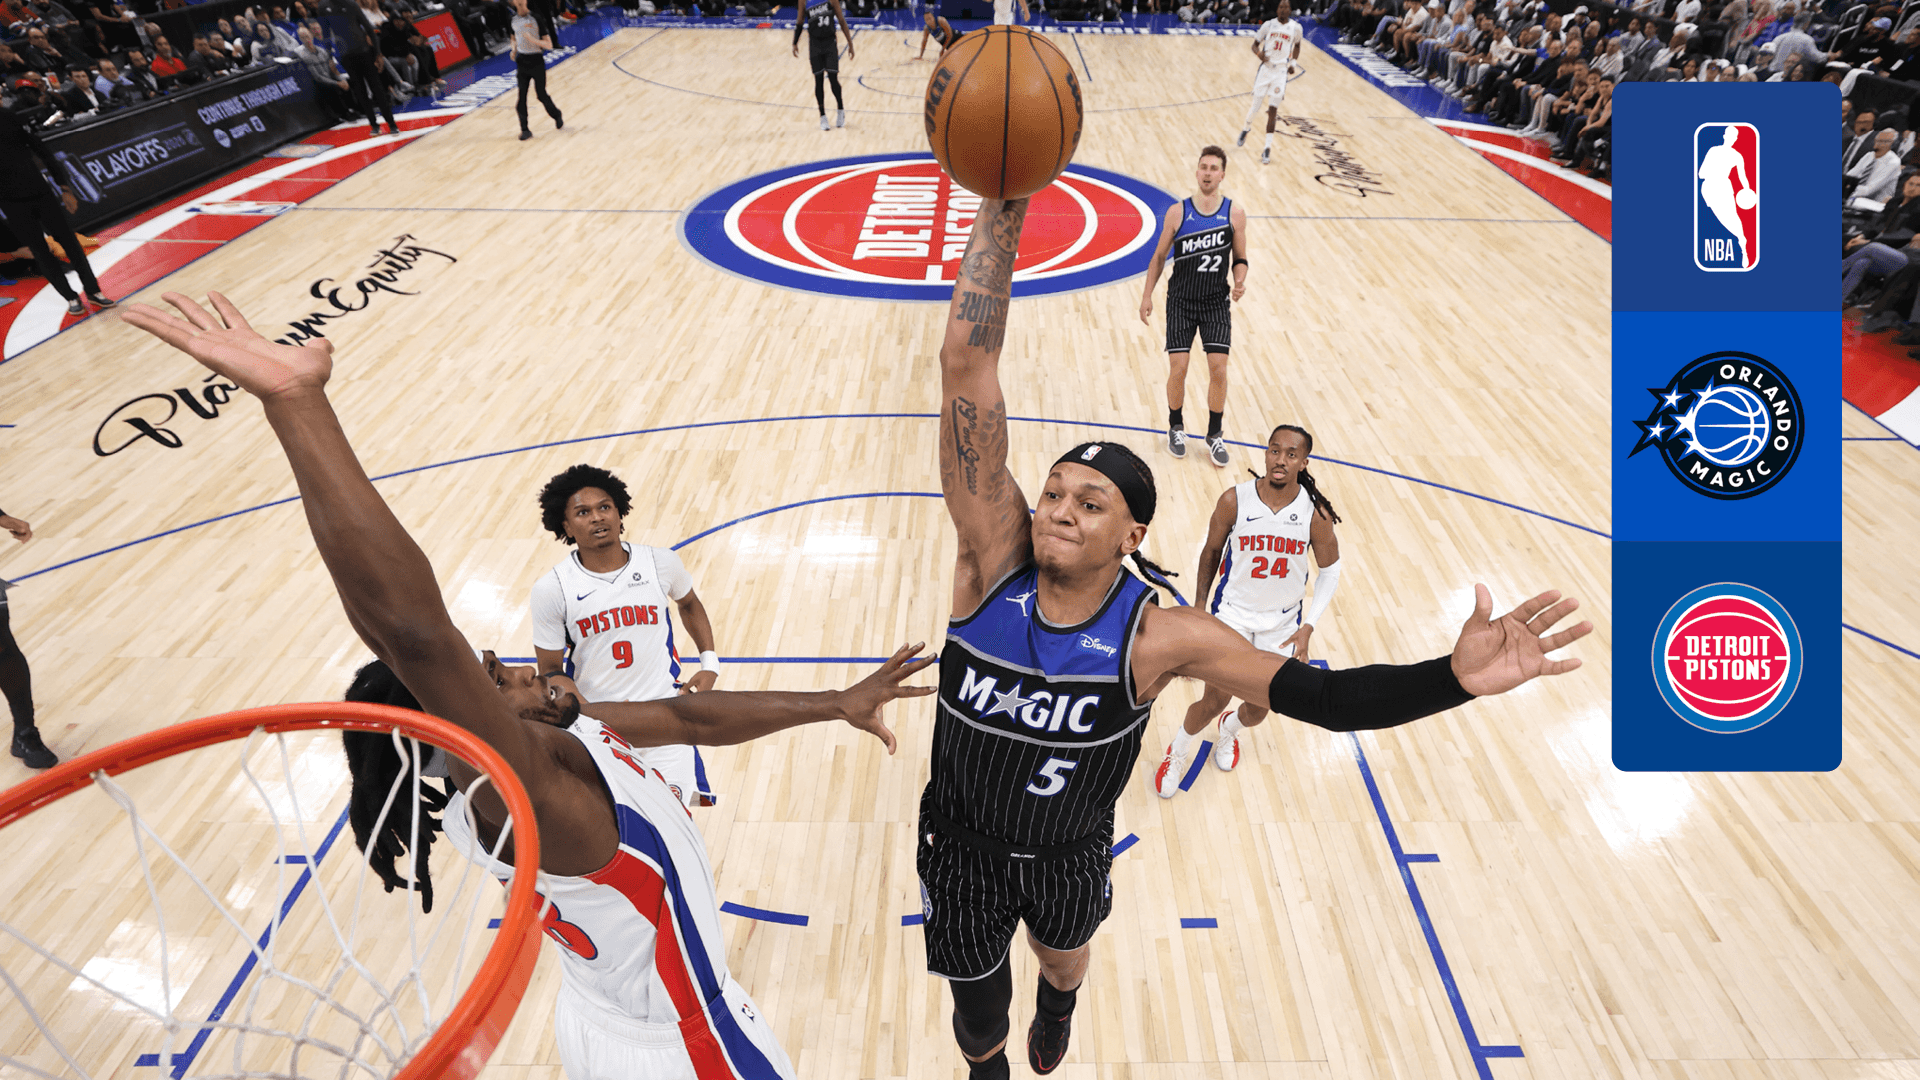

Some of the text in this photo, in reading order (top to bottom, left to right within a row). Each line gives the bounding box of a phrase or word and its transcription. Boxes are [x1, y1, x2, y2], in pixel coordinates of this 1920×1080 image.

[817, 15, 830, 27] 34
[1273, 40, 1283, 51] 31
[197, 95, 247, 125] CONTINUE
[86, 137, 169, 183] PLAYOFFS
[852, 174, 940, 260] DETROIT
[310, 233, 457, 312] Equity
[1197, 255, 1222, 272] 22
[1238, 535, 1307, 555] PISTONS
[1251, 556, 1290, 579] 24
[576, 605, 658, 638] PISTONS
[612, 640, 634, 669] 9
[1024, 756, 1080, 797] 5
